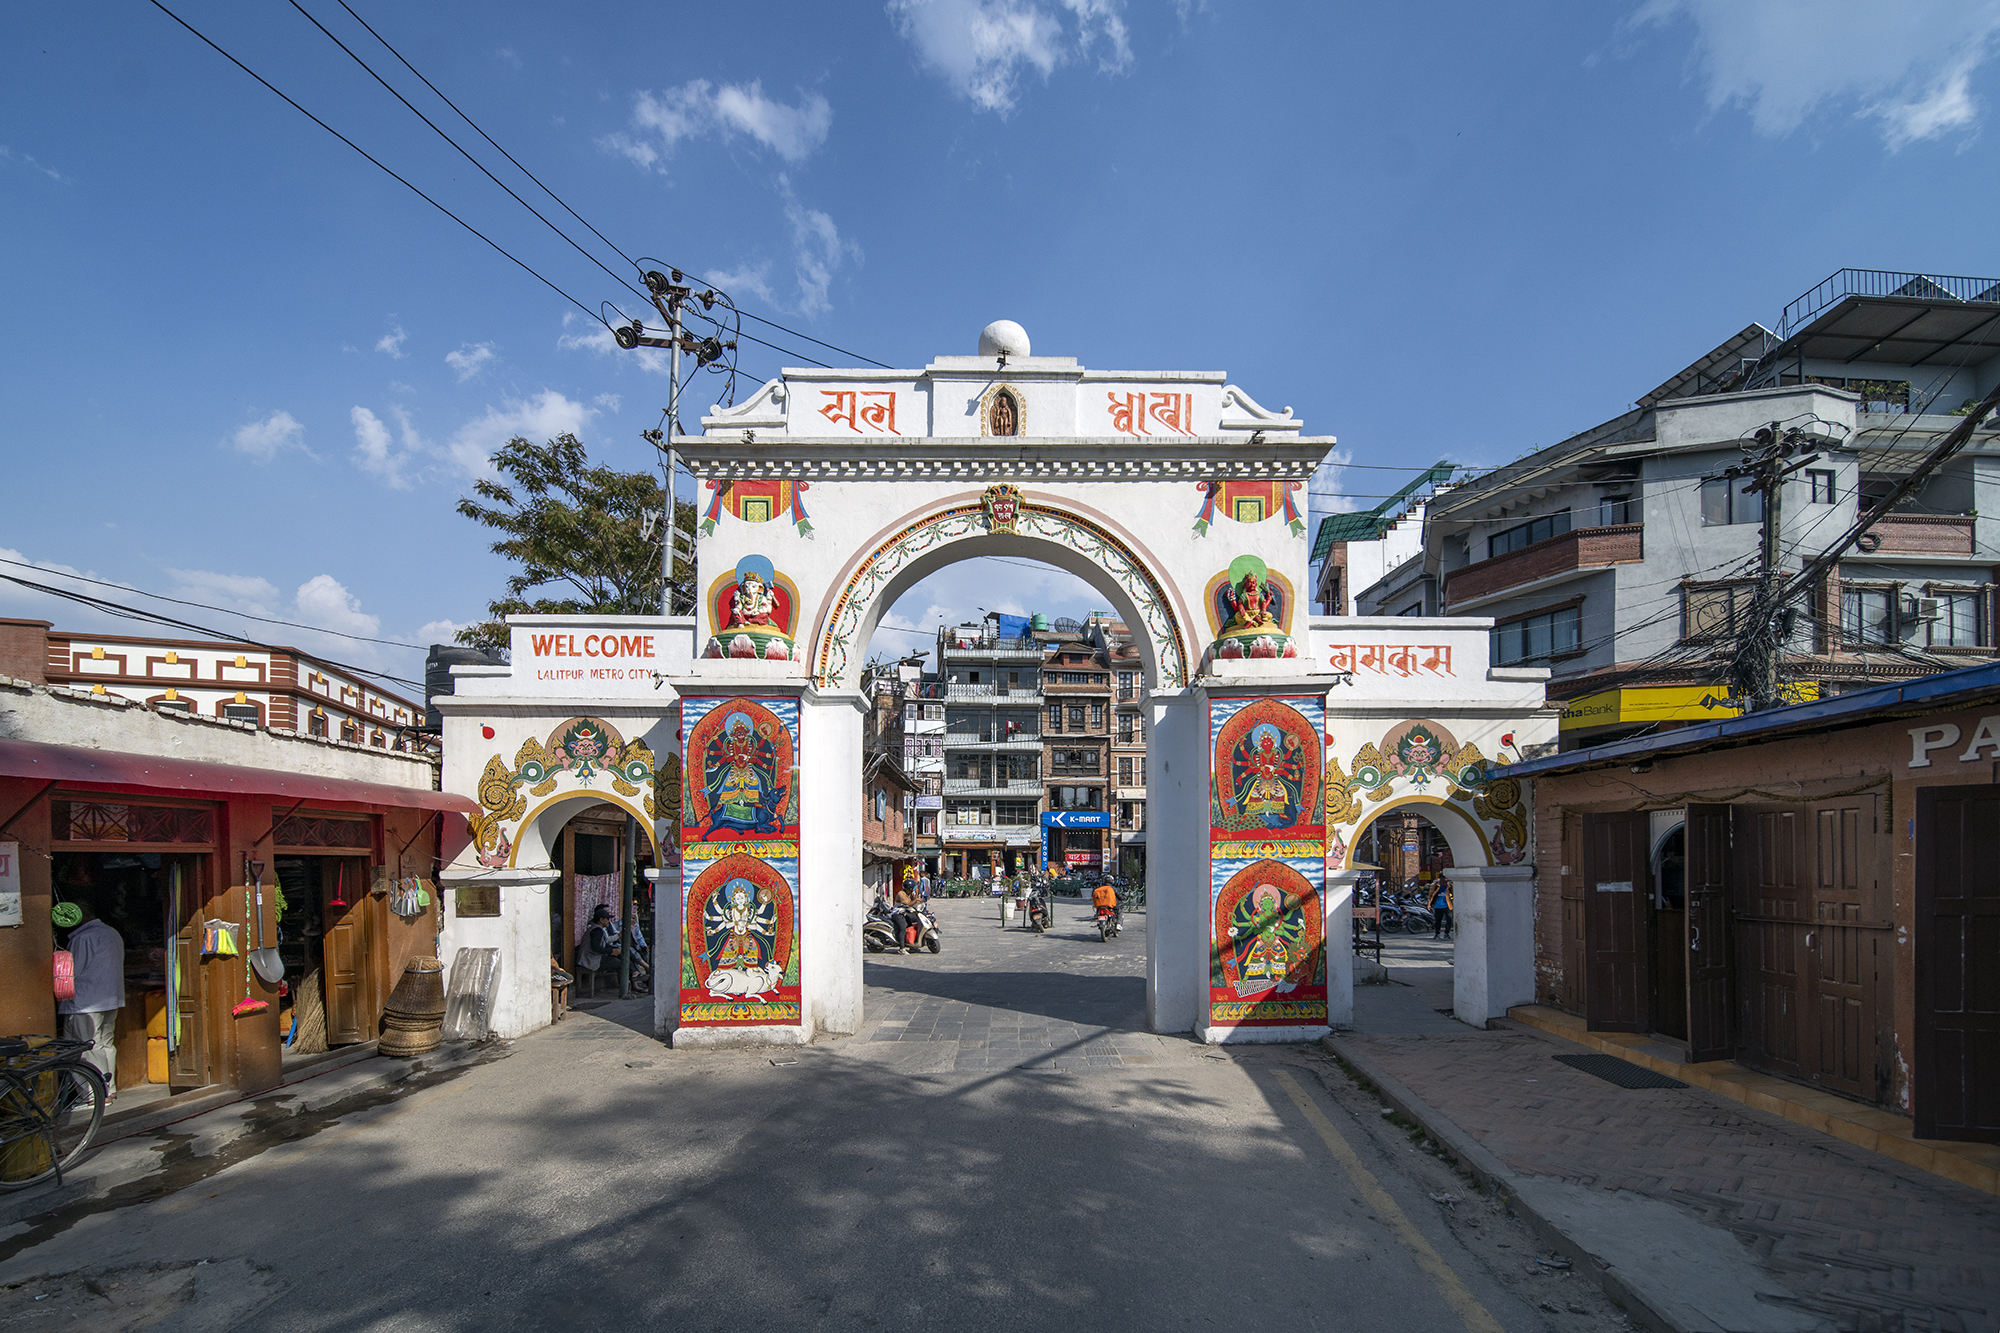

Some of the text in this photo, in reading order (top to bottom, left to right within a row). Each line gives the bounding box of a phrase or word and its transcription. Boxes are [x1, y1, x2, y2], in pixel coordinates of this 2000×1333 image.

[531, 634, 656, 658] WELCOME
[537, 668, 653, 680] LALITPUR METRO CITY
[1069, 815, 1101, 823] K-MART
